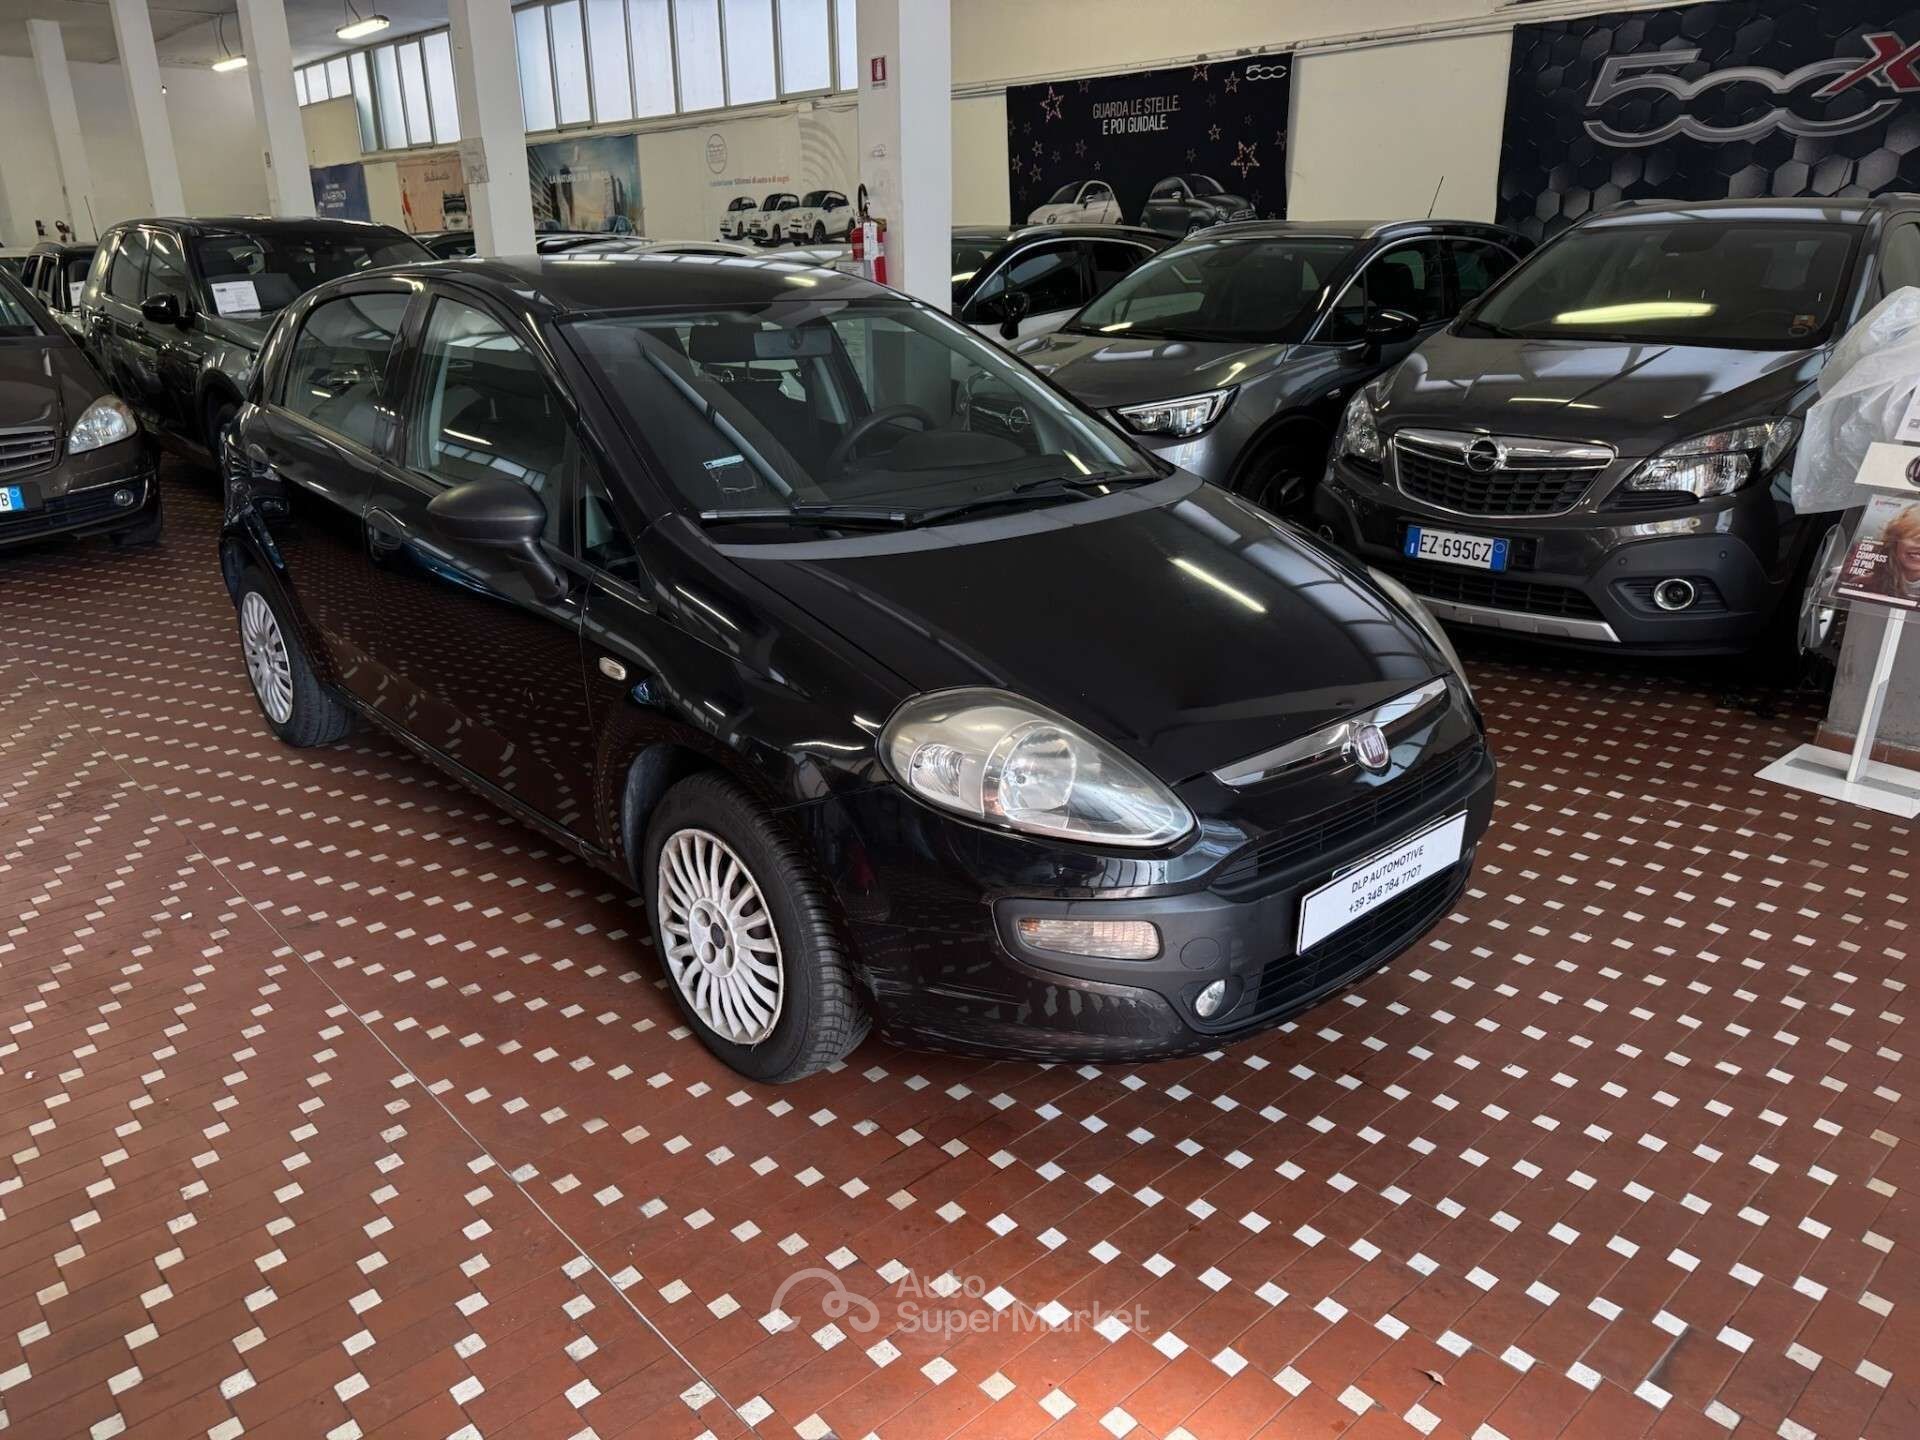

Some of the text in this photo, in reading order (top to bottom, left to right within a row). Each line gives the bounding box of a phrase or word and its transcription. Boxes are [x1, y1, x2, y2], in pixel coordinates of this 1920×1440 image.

[1245, 64, 1287, 81] 500
[1093, 101, 1128, 119] GUARDA
[1130, 99, 1142, 116] LE
[1102, 114, 1169, 135] E POI GUIDALE.
[1419, 534, 1439, 555] EZ
[1442, 538, 1492, 562] 695GZ
[1856, 551, 1888, 563] COMPASS
[1859, 543, 1874, 551] CON
[1351, 845, 1424, 893] DLP AUTOMOTIVE
[1348, 865, 1422, 914] +39 348 784 7707
